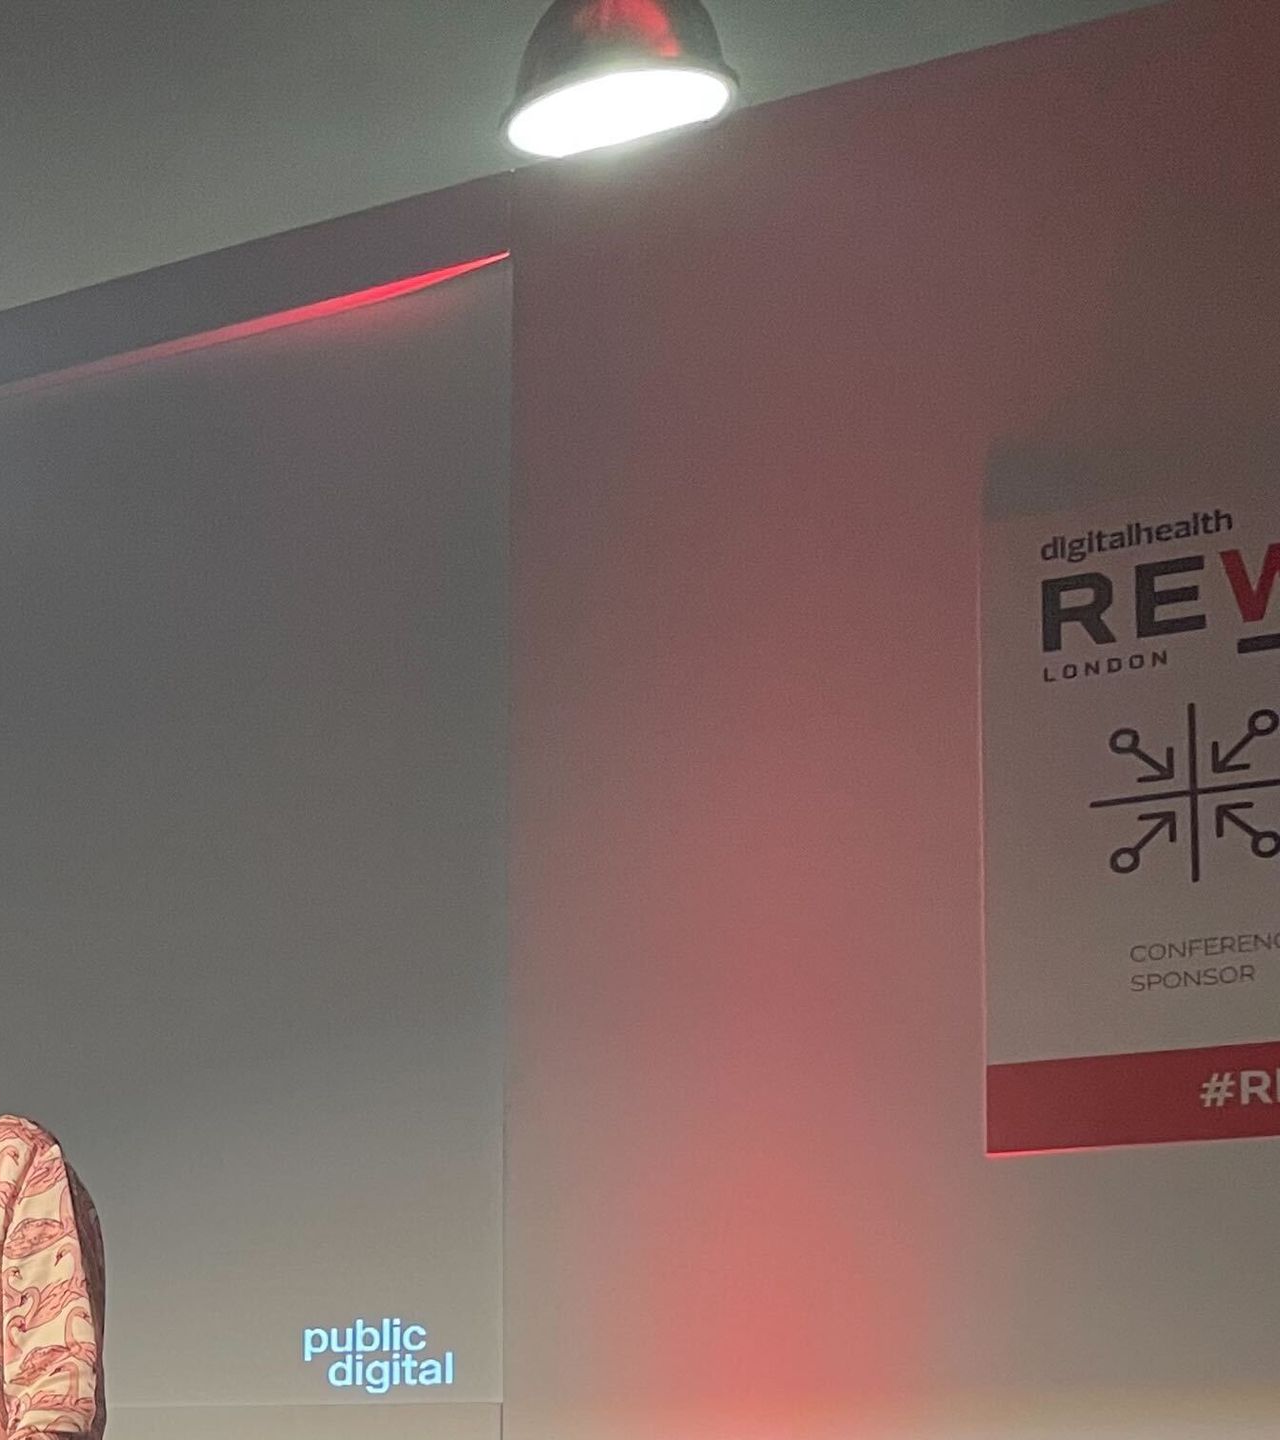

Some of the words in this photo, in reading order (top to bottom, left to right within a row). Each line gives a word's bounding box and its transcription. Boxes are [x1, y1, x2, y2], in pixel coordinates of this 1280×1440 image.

[1041, 509, 1233, 563] digitalhealth
[1044, 650, 1168, 682] LONDON
[1129, 965, 1256, 992] SPONSOR
[1199, 1067, 1280, 1108] #R
[303, 1318, 427, 1361] public
[328, 1351, 453, 1394] digital
